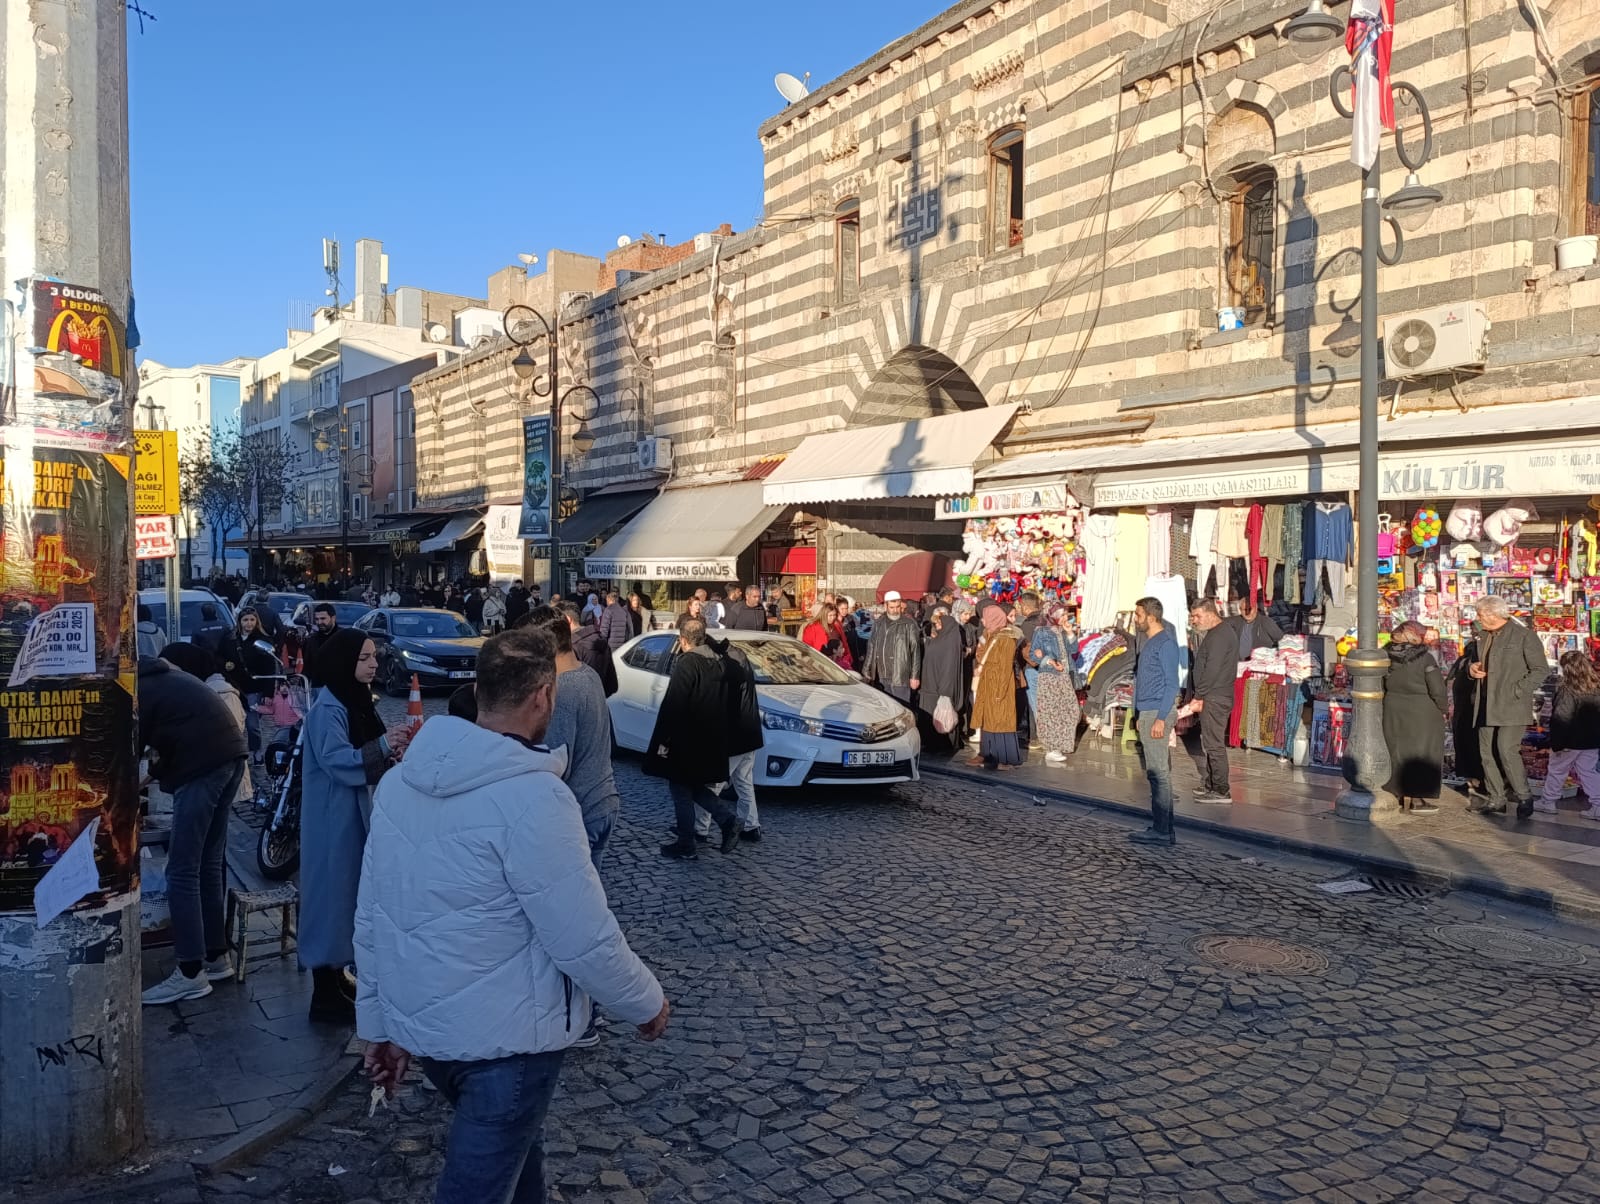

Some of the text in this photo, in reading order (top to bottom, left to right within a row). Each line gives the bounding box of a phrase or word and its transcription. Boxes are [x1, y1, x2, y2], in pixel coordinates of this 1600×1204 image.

[50, 286, 59, 297] 3
[69, 300, 109, 315] BEDAVA
[136, 472, 158, 481] AĞI
[1383, 459, 1505, 494] KÜLTÜR
[135, 483, 163, 491] DİLMEZ
[943, 489, 1053, 513] ONUR OYUNCAK
[136, 522, 166, 534] YAR
[624, 564, 647, 577] ÇANTA
[656, 565, 690, 576] EYMEN
[72, 610, 83, 630] 2025
[46, 632, 82, 643] 20.00
[0, 691, 35, 708] OTRE
[8, 705, 82, 723] KAMBURU
[848, 752, 858, 764] 06
[862, 752, 872, 763] ED
